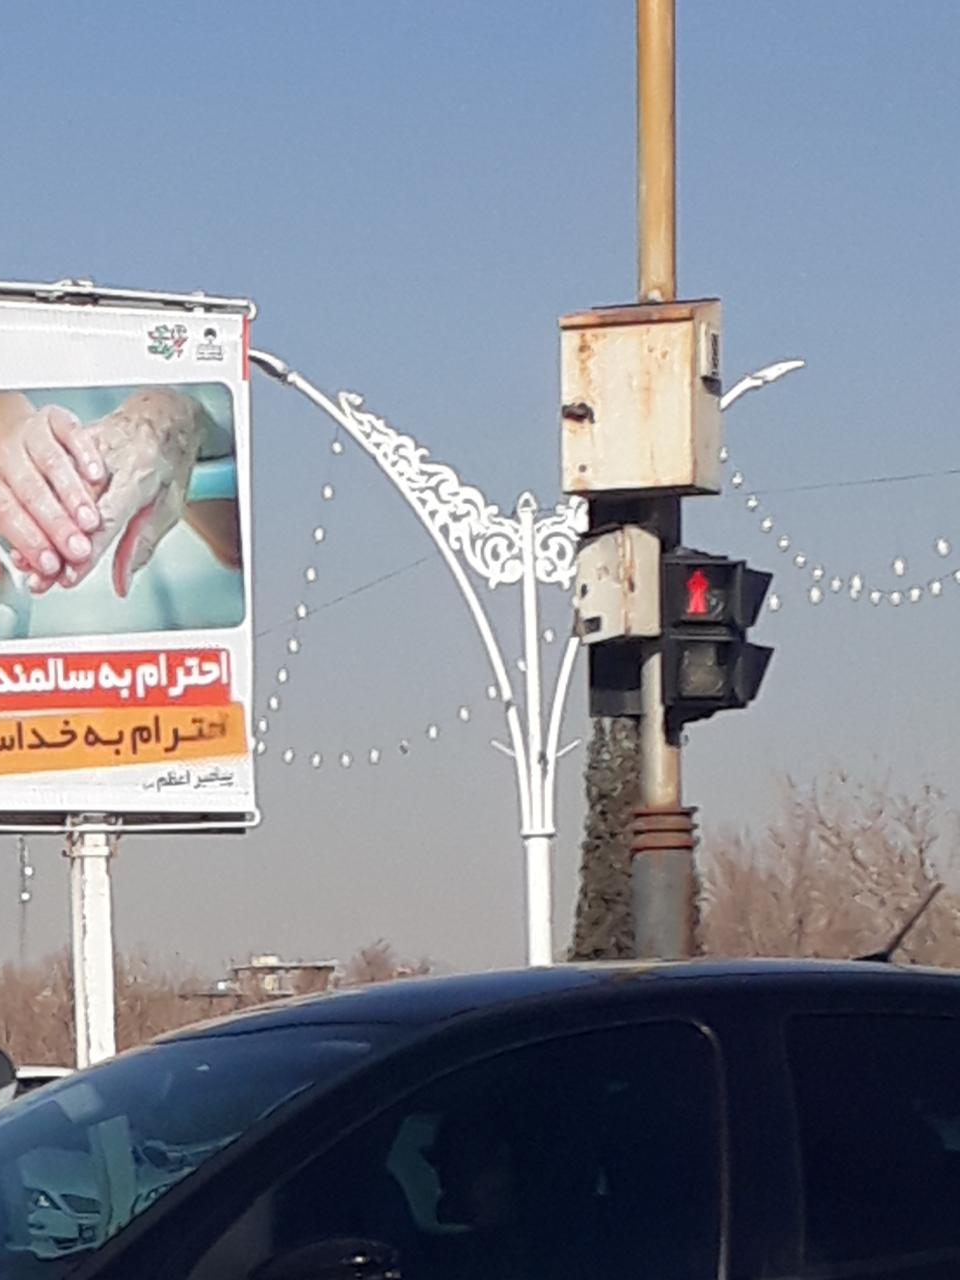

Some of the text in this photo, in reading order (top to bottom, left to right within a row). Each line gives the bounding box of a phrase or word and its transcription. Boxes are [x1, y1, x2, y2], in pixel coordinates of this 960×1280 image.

[98, 662, 132, 699] به
[136, 652, 229, 699] احترام
[83, 724, 124, 756] به
[156, 769, 190, 793] اعظم
